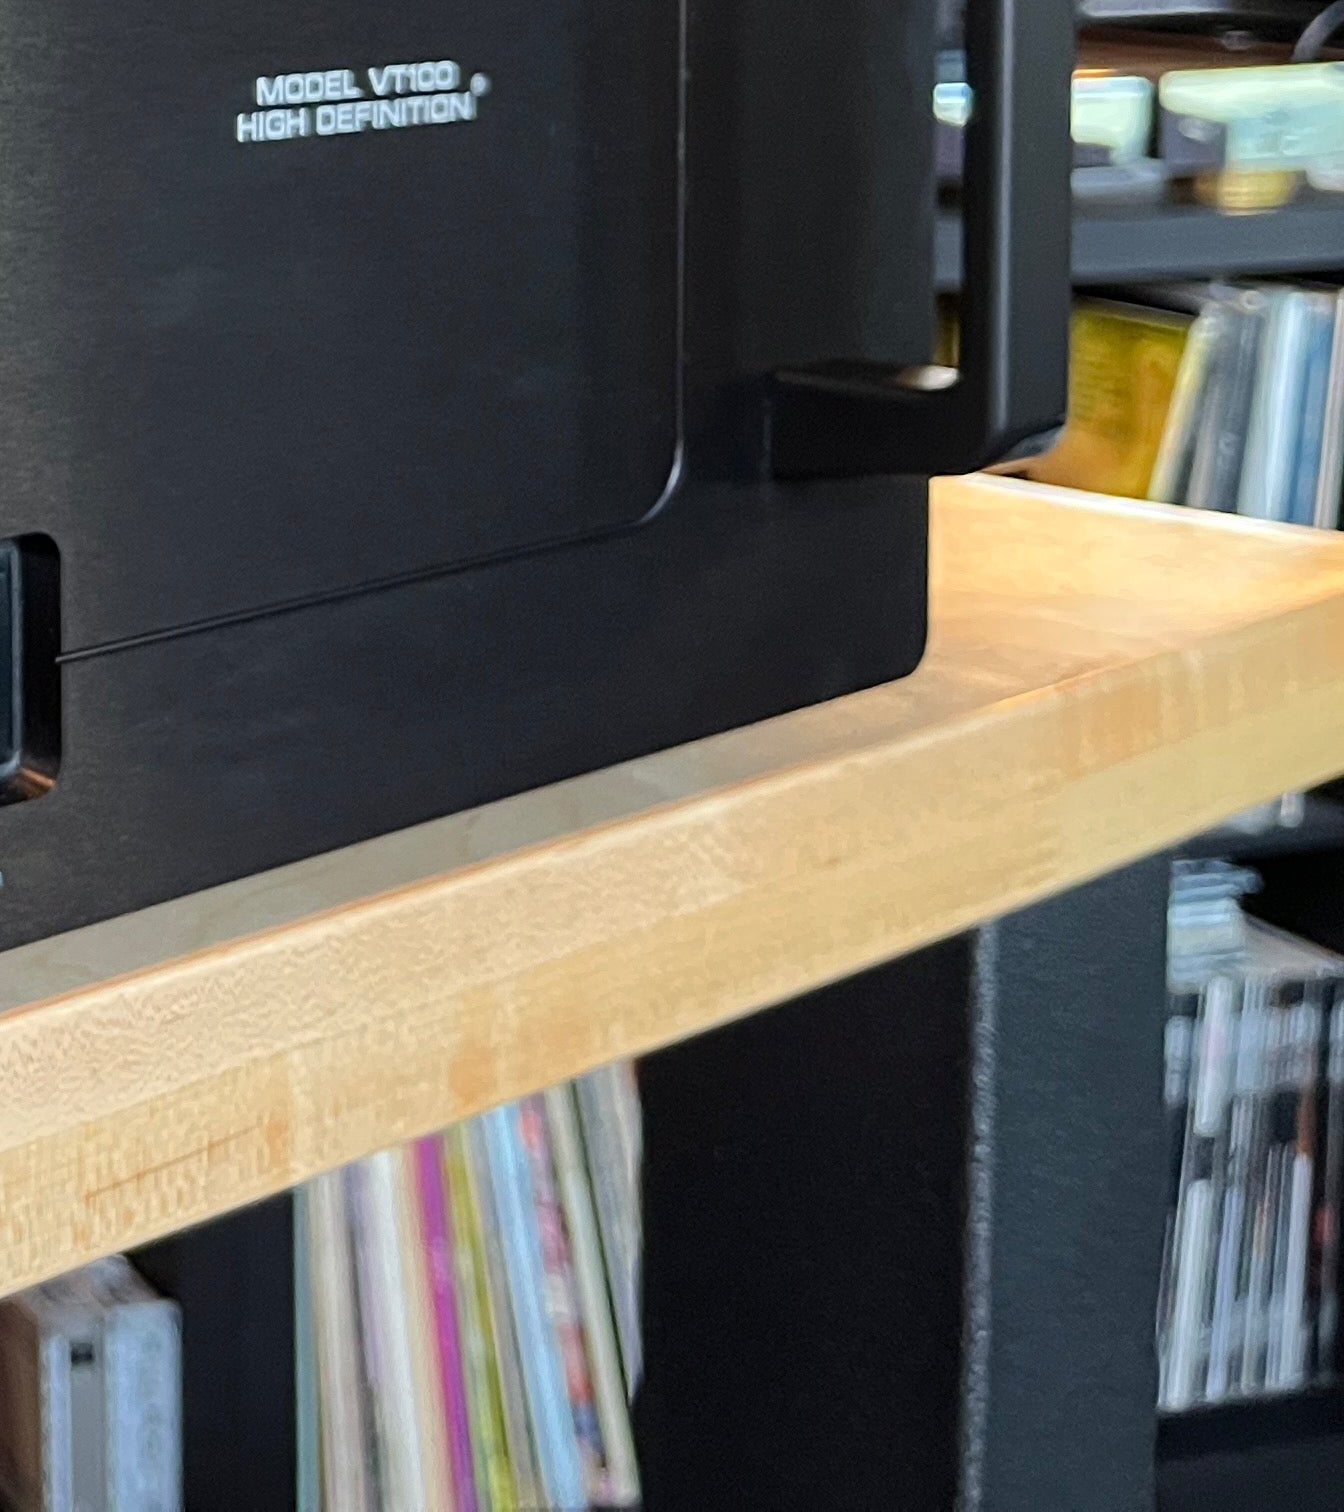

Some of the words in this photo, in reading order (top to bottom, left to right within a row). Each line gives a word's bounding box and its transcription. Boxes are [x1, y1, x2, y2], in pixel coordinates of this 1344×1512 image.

[255, 69, 361, 106] MODEL
[368, 60, 460, 96] VT100
[236, 107, 311, 143] HIGH
